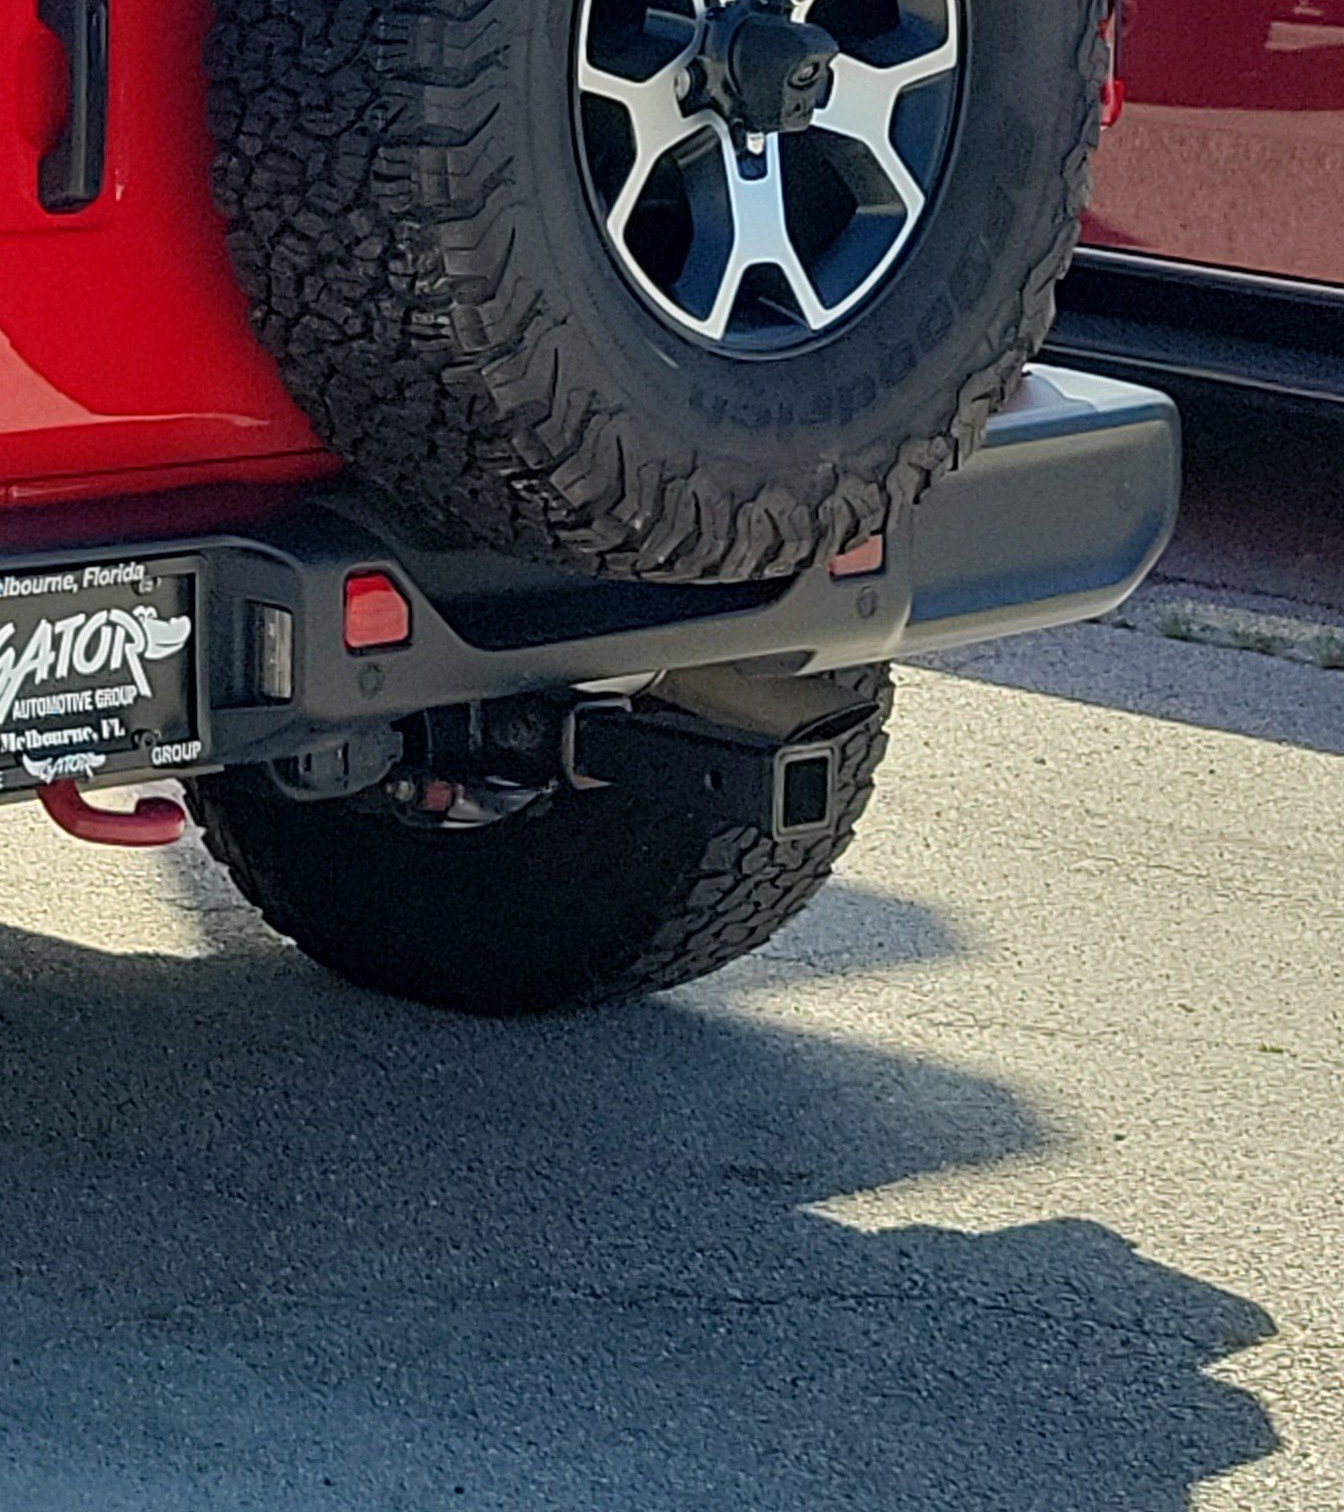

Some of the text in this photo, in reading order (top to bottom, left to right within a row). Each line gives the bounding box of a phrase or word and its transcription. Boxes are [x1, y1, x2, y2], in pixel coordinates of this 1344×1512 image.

[82, 561, 146, 589] Florida
[12, 684, 138, 721] AUTOMOTIVE GROUP
[0, 717, 126, 753] Melbourne, FL
[151, 740, 202, 767] GROUP
